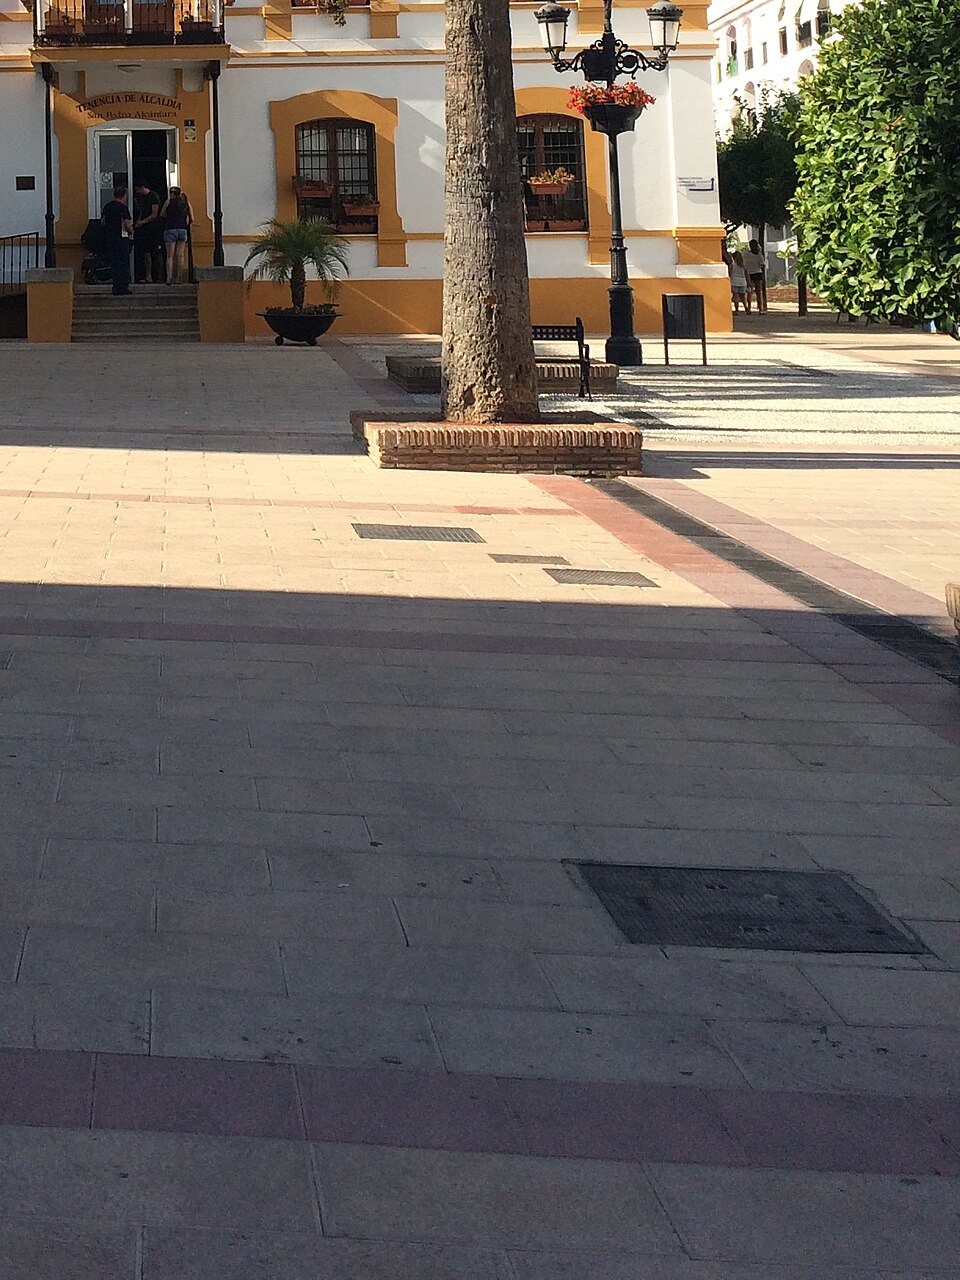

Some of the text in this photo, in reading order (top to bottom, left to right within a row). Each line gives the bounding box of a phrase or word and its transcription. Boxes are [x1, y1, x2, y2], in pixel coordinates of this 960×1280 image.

[76, 95, 122, 113] TENENCIA
[125, 94, 136, 102] DE
[87, 111, 104, 119] San
[106, 110, 131, 119] Pedro
